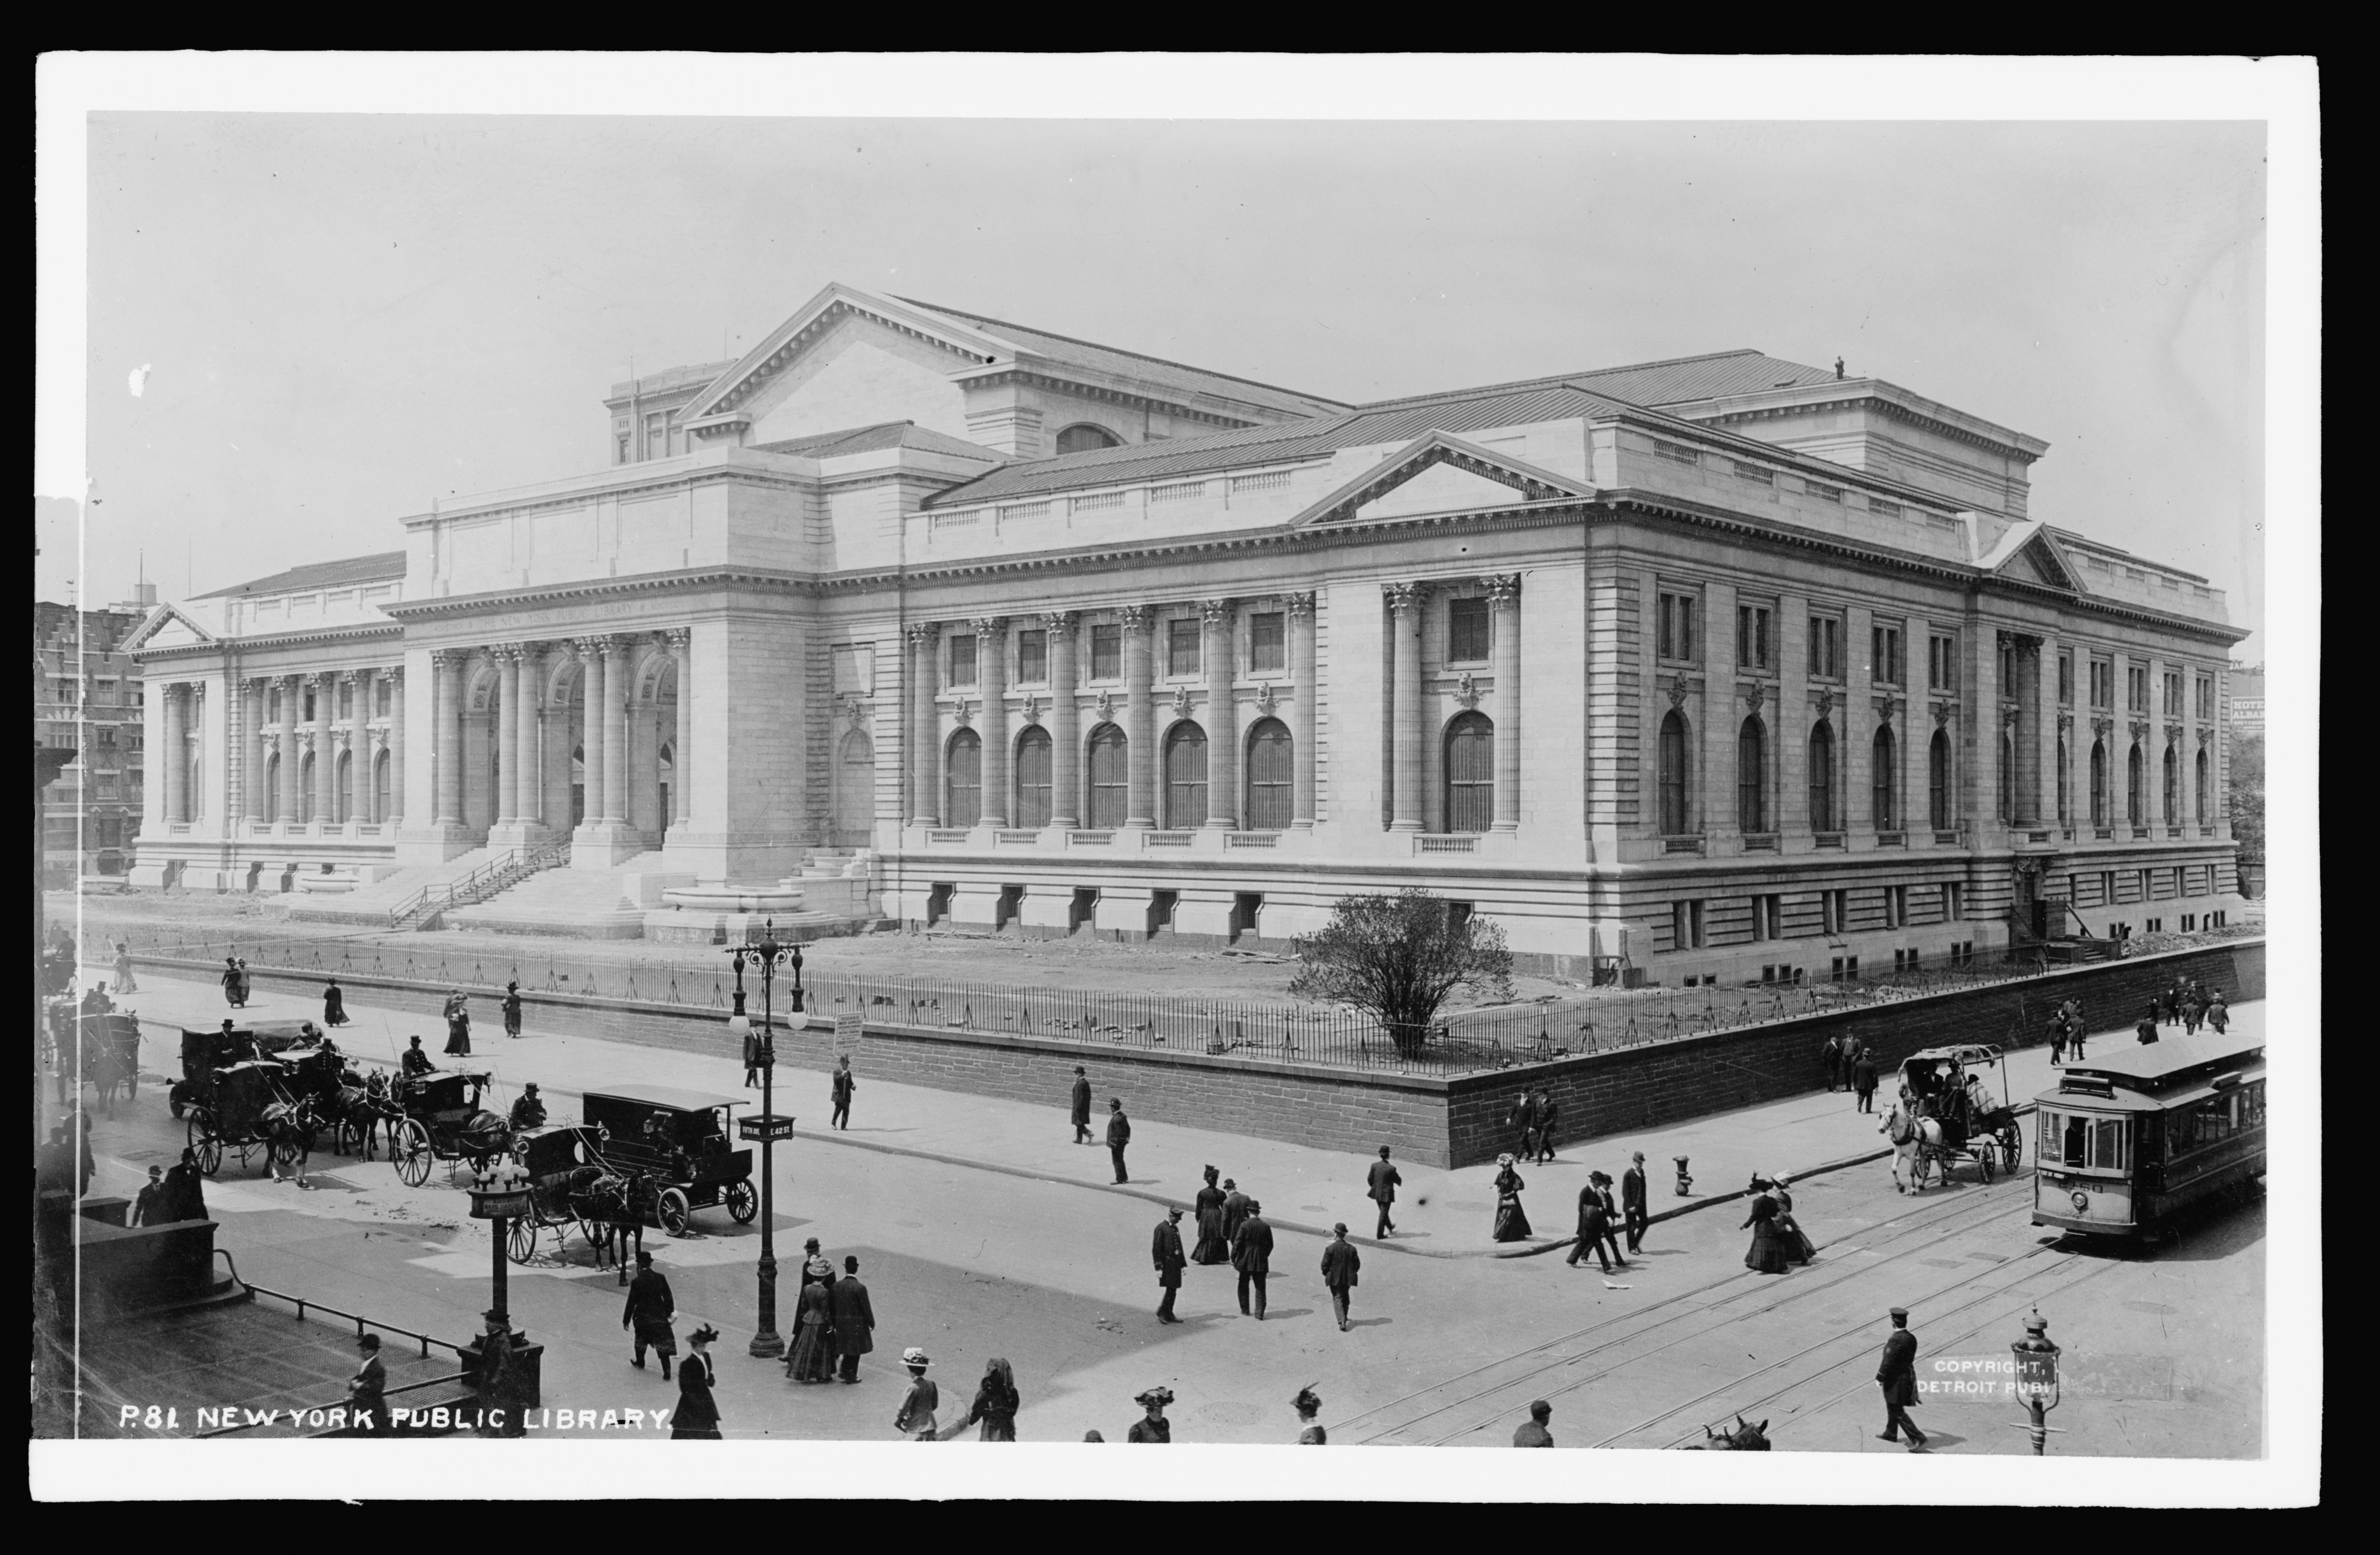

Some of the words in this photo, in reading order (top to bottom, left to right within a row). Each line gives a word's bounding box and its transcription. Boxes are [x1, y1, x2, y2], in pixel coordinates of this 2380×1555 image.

[501, 615, 521, 625] NEW
[528, 612, 550, 624] YORK
[556, 608, 588, 620] PUBLIC
[595, 603, 634, 617] LIBRARY
